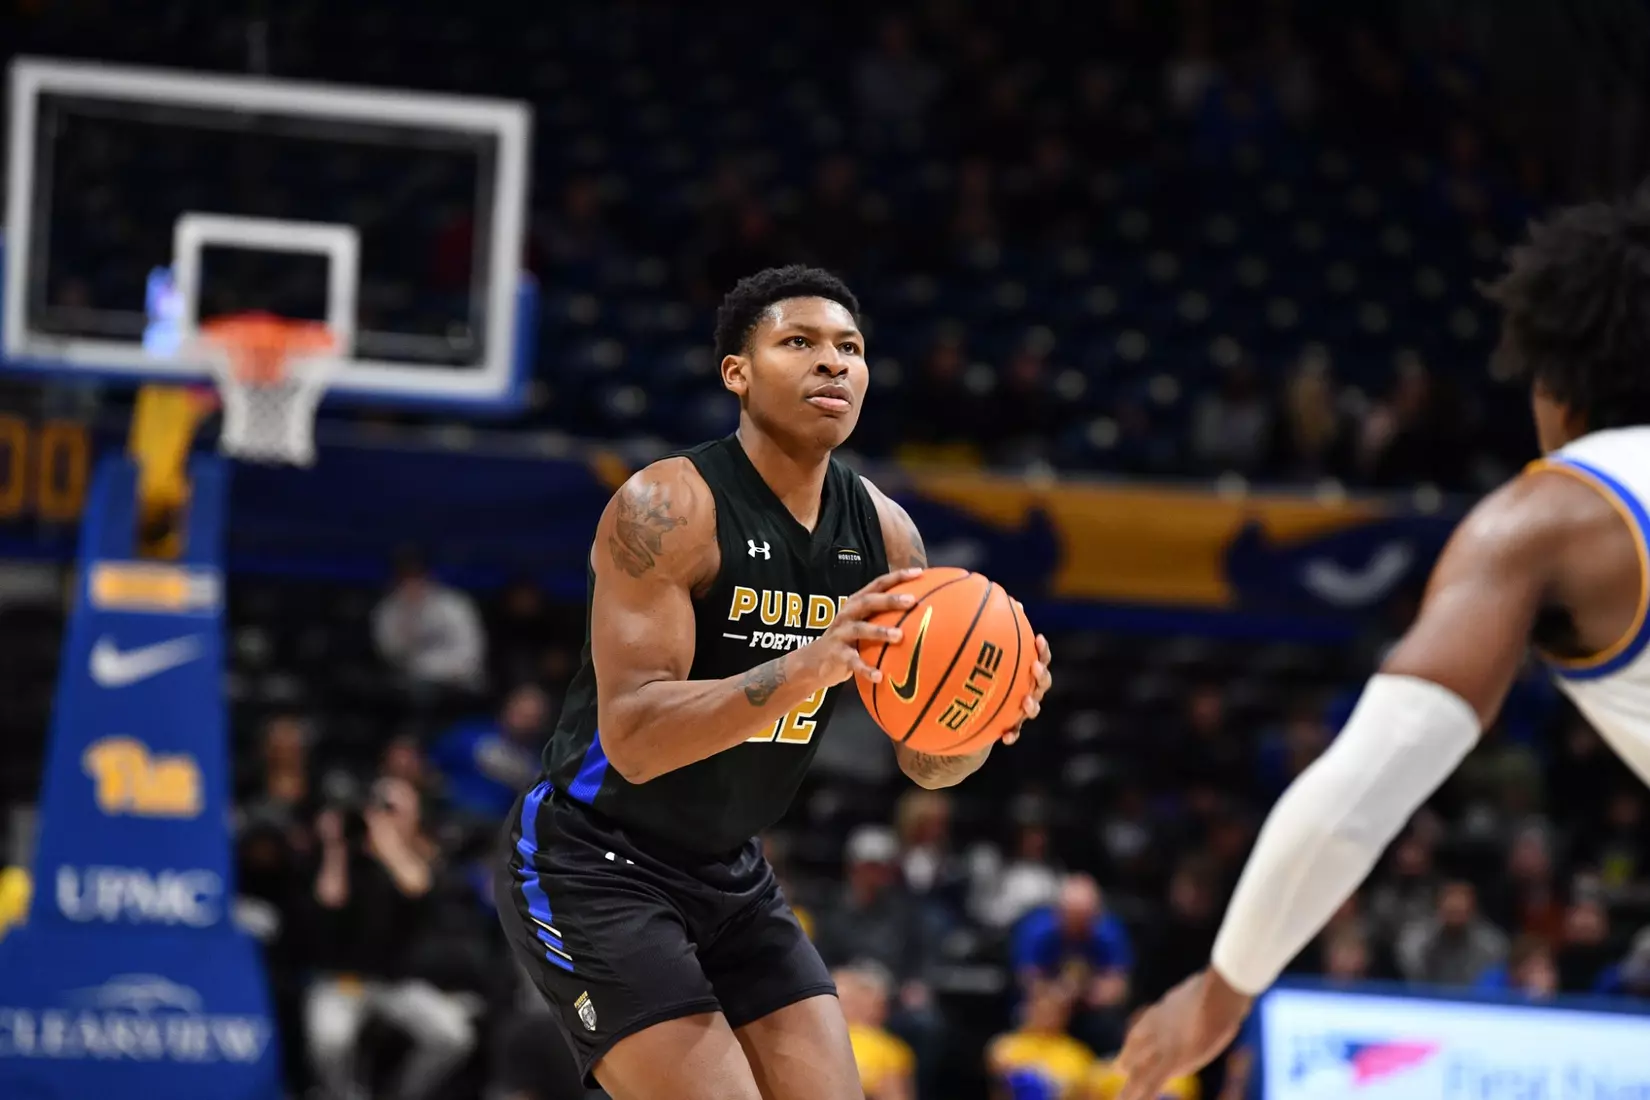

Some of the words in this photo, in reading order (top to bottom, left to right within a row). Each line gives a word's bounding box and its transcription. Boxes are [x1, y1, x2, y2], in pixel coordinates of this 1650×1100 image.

[728, 585, 850, 630] PURD
[749, 631, 822, 650] FORTW
[937, 640, 1003, 731] ELITE
[745, 686, 826, 744] 2
[57, 865, 222, 926] UPMC
